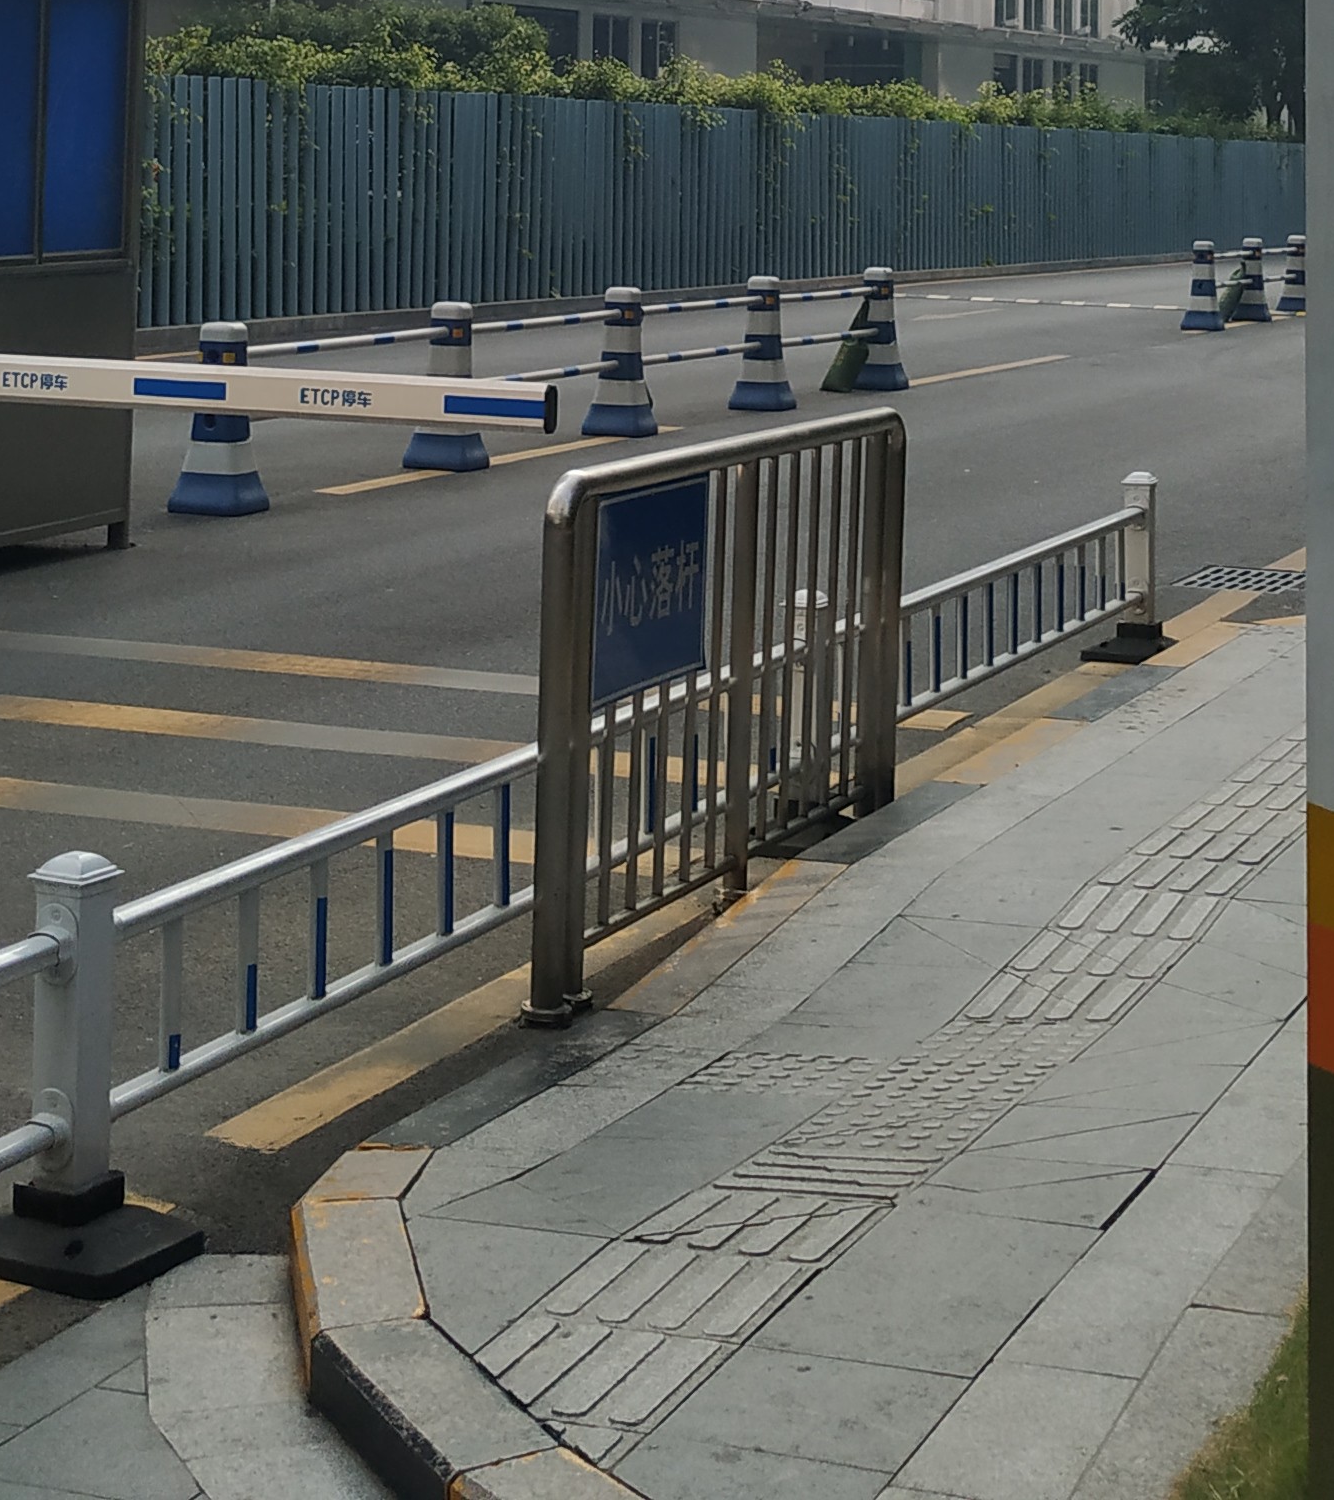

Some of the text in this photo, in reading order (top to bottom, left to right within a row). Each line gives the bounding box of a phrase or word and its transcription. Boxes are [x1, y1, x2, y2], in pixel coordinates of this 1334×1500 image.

[2, 371, 69, 391] ETCP停车
[299, 386, 373, 408] ETCP停车
[600, 539, 700, 637] 小心落杆
